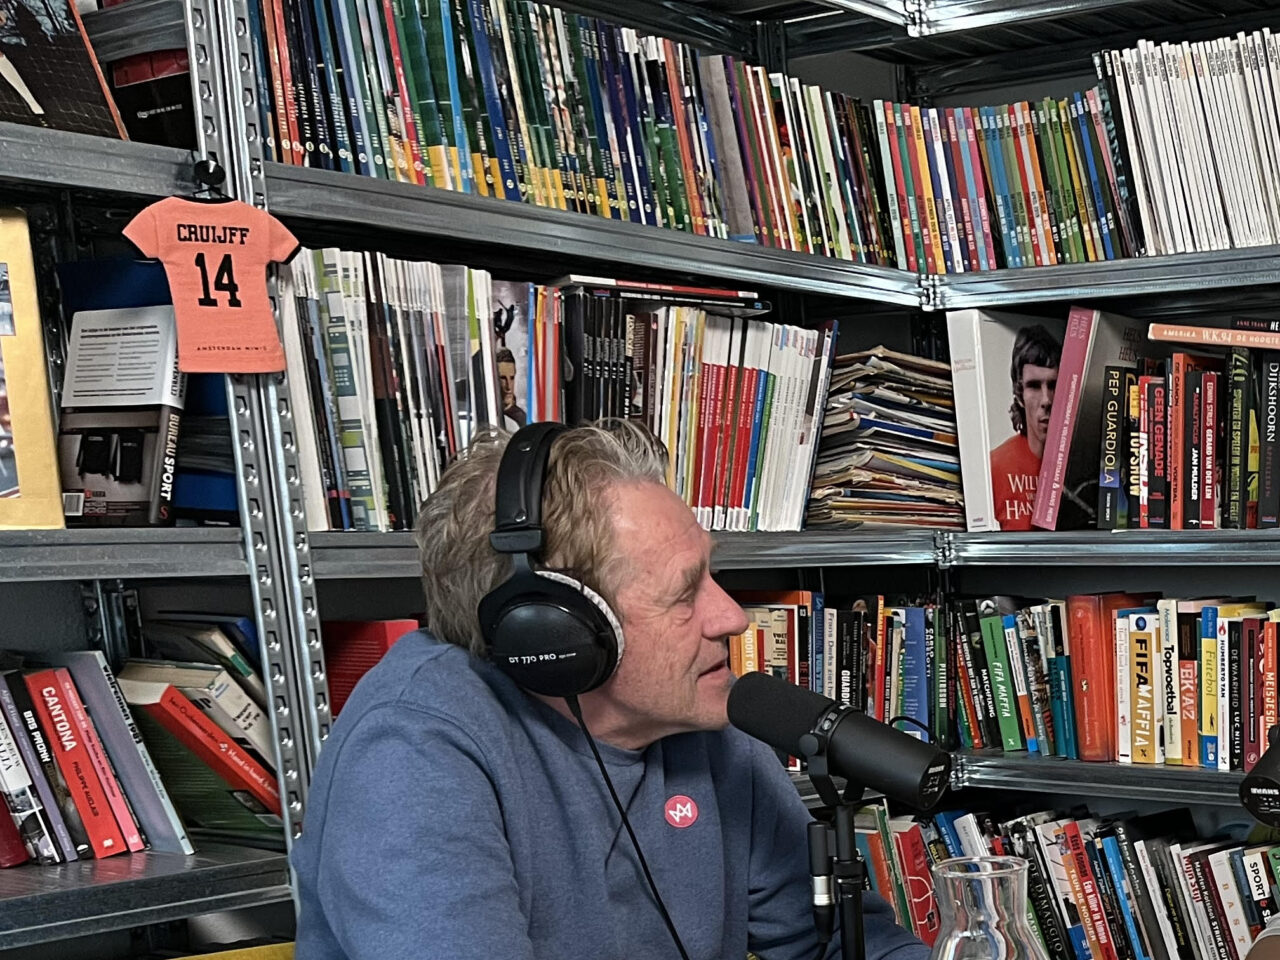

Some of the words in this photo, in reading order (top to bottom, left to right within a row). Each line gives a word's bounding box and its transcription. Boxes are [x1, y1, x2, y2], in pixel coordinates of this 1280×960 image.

[177, 223, 249, 245] CRUIJFF
[195, 252, 242, 308] 14
[1108, 370, 1119, 396] PEP
[1154, 387, 1164, 421] GEEN
[1266, 362, 1279, 442] DIJKSHOORN
[165, 413, 180, 459] BUREAU
[1104, 400, 1118, 483] GUARDIOLA
[1154, 424, 1164, 477] GENADE
[160, 458, 176, 501] SPORT
[508, 656, 519, 664] DT
[522, 653, 537, 664] 770
[539, 653, 556, 662] PRO
[992, 662, 1006, 682] FIFA
[1205, 650, 1216, 697] Futebol
[980, 669, 995, 718] MATCHFIXING
[996, 684, 1011, 718] MAFFIA
[23, 710, 36, 730] BAS
[32, 731, 50, 762] PRONK
[41, 687, 77, 752] CANTONA
[72, 761, 89, 789] PHILIPPE
[83, 791, 99, 817] AUCLAIR
[1026, 856, 1039, 877] JOE
[1034, 884, 1063, 951] DIMAGGIO
[1069, 868, 1081, 890] TEUN
[1076, 893, 1085, 903] DE
[1081, 905, 1096, 941] NOOIJER
[1194, 861, 1206, 890] Maarten
[1211, 921, 1223, 946] STRIKE
